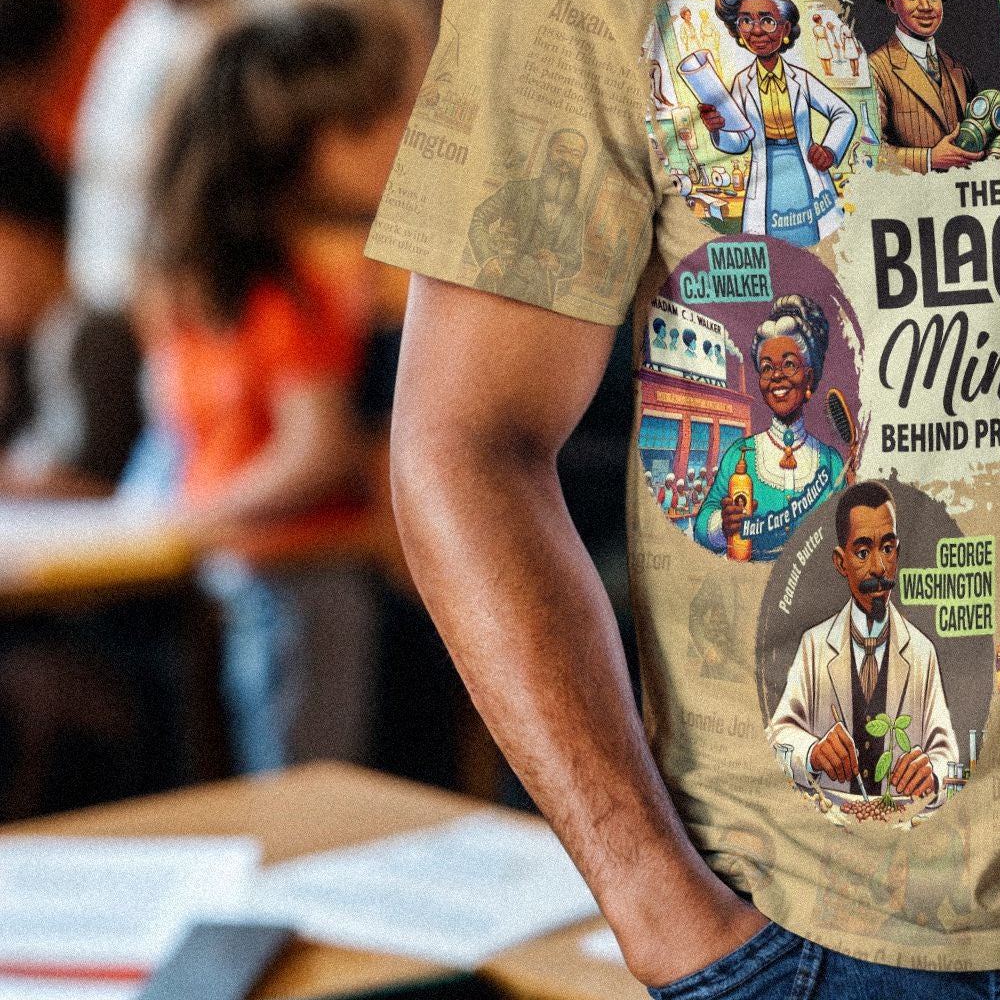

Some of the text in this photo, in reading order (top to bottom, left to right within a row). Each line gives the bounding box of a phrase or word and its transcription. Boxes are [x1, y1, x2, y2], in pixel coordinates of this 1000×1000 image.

[771, 194, 832, 229] Sanitary Belt
[710, 246, 767, 270] MADAM
[683, 273, 770, 299] C.J. WALKER
[651, 298, 679, 317] MADAM
[696, 315, 722, 335] WALKER
[881, 420, 969, 453] BEHIND
[743, 468, 829, 537] Hair Care Products
[939, 540, 993, 568] GEORGE
[778, 526, 825, 615] Peanut Butter
[902, 571, 993, 600] WASHINGTON
[939, 603, 993, 632] CARVER
